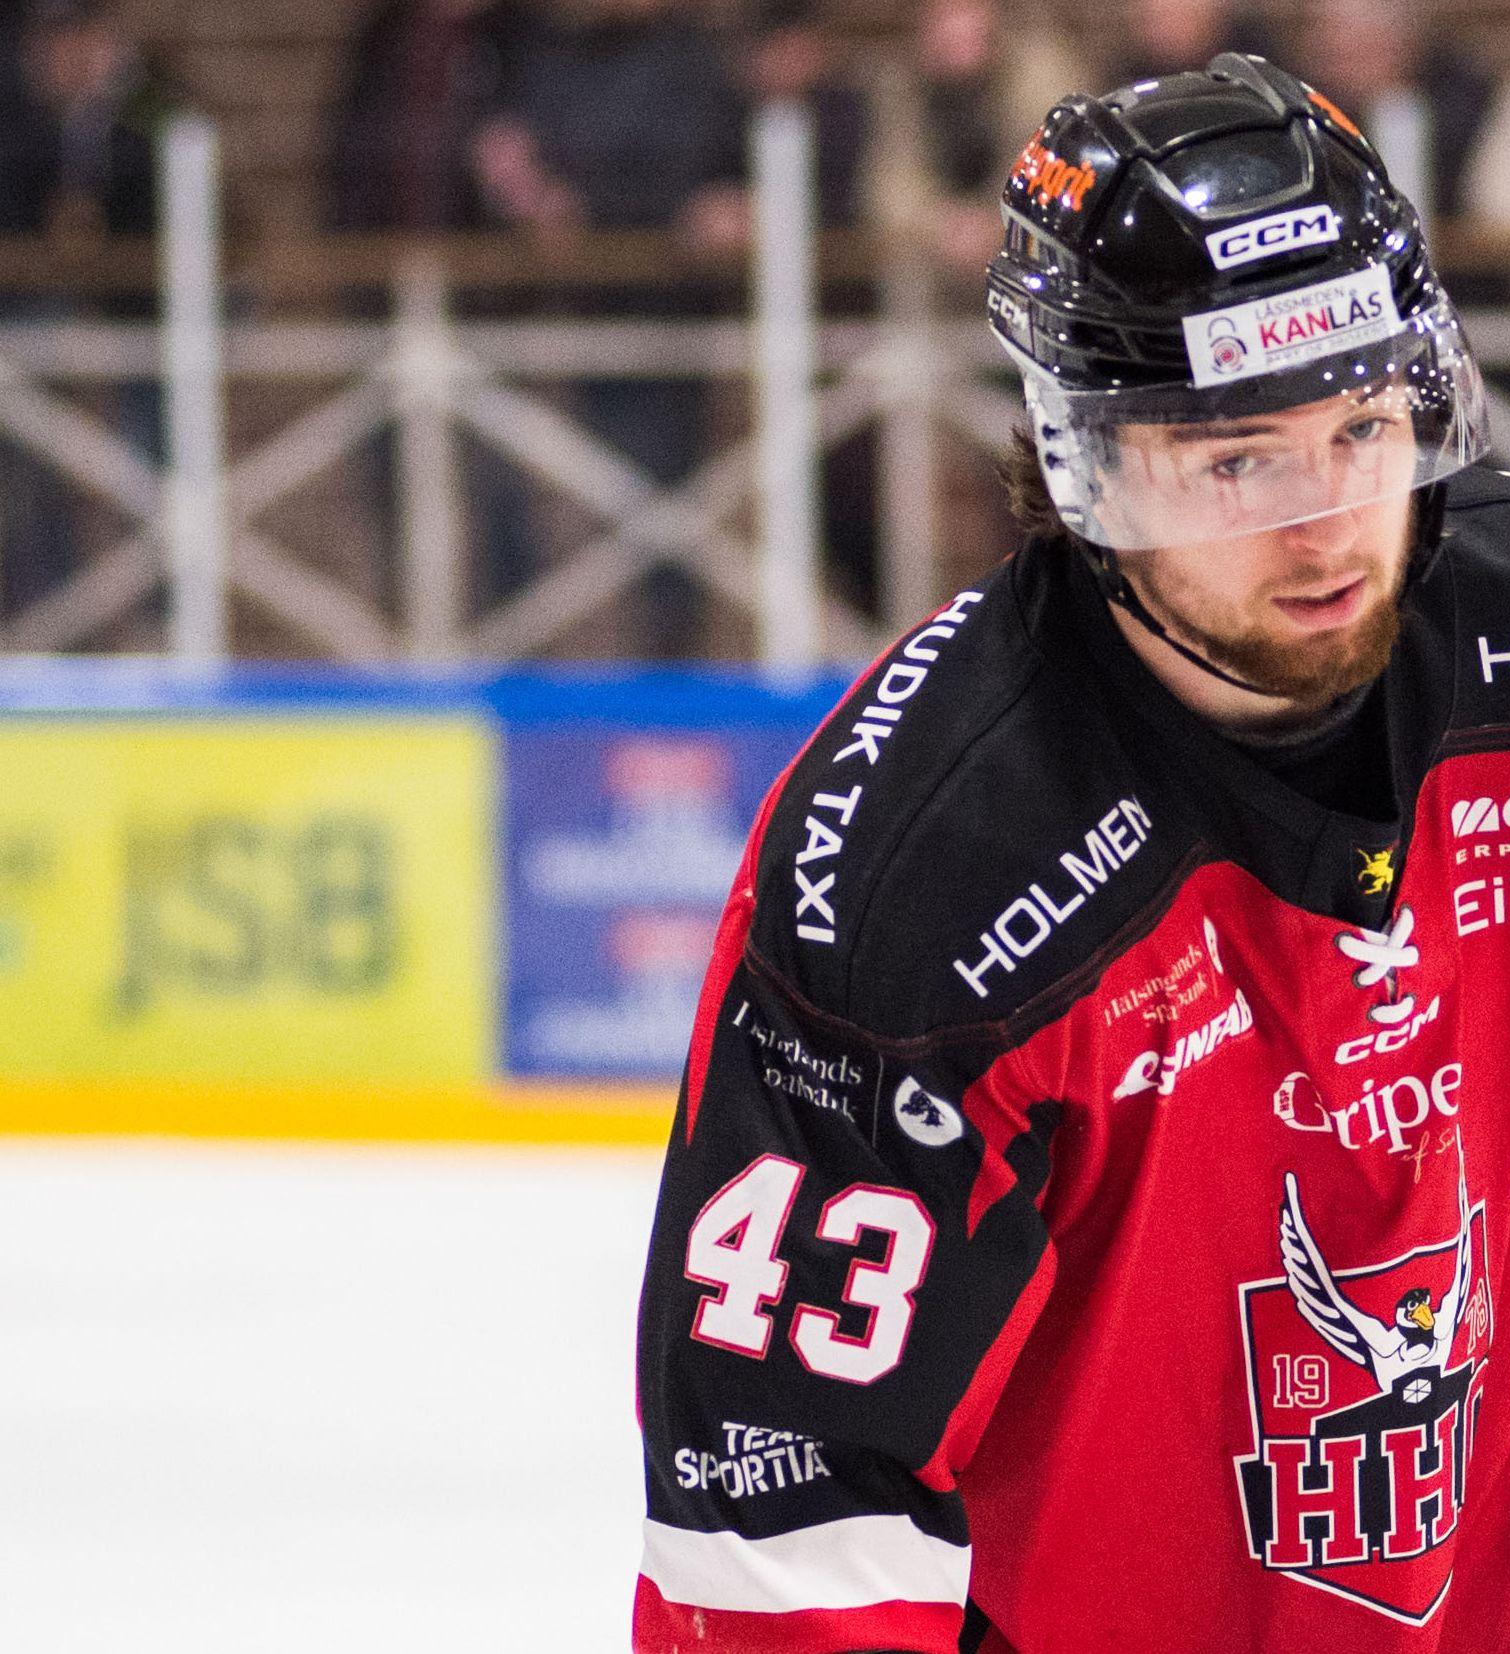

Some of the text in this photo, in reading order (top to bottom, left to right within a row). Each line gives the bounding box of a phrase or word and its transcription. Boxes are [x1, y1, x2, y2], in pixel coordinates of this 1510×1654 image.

[1219, 214, 1328, 258] CCM
[987, 289, 1029, 332] CCM
[795, 591, 985, 945] HUDIK TAXI
[952, 794, 1154, 999] HOLMEN
[1333, 995, 1440, 1066] CCM
[684, 1152, 938, 1386] 43
[1272, 1354, 1330, 1409] 19
[721, 1421, 815, 1457] TEA
[674, 1441, 832, 1499] SPORTIA
